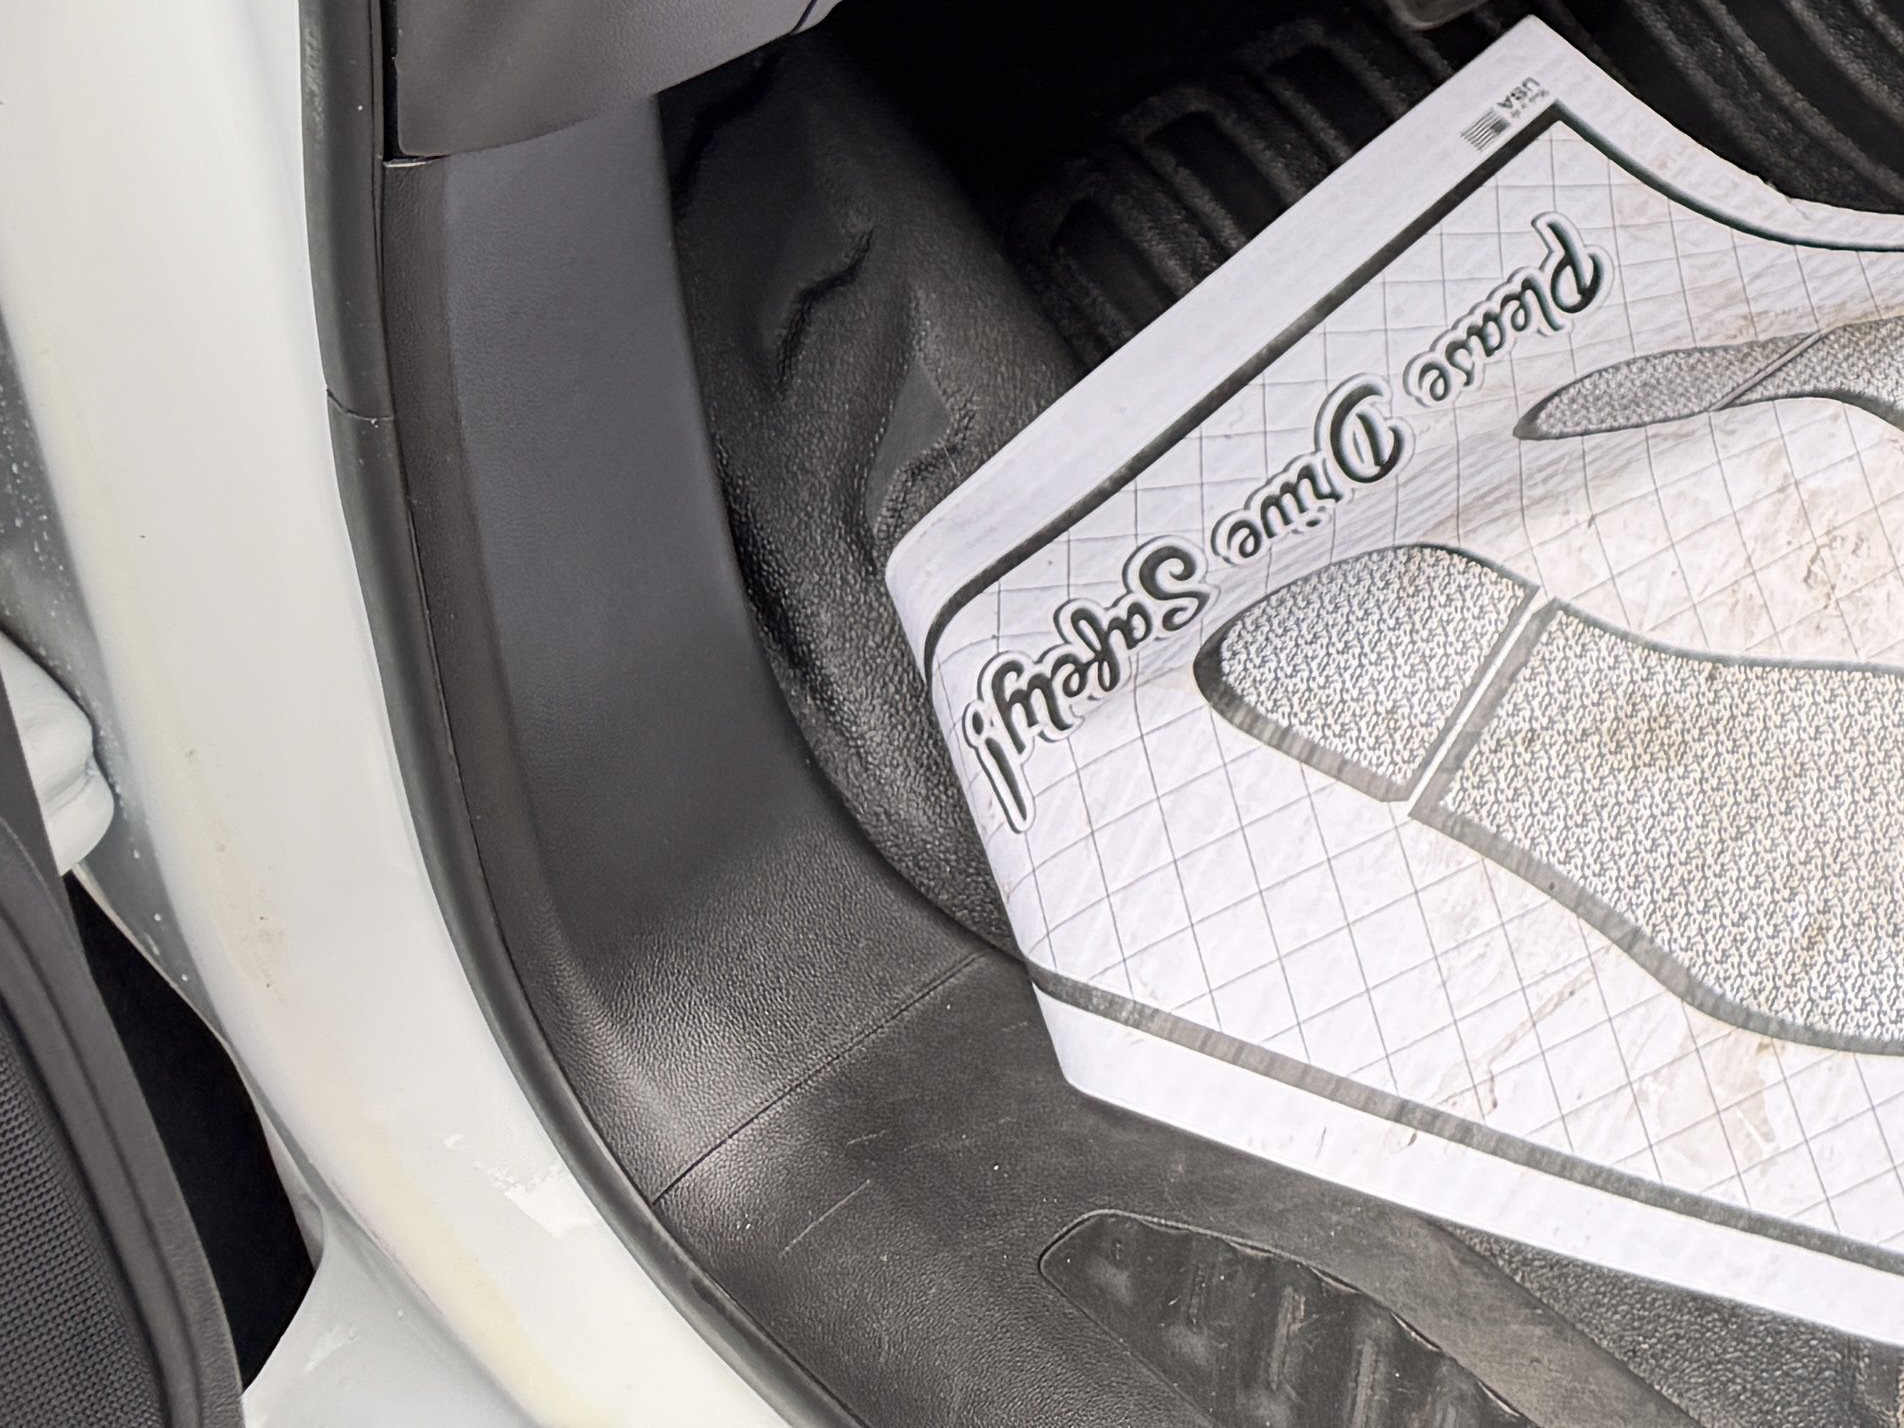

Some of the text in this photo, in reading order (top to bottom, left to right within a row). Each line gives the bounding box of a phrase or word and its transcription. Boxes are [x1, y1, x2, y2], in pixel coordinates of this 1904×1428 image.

[1496, 76, 1541, 110] USA
[965, 212, 1611, 832] Please Drive Safely!
